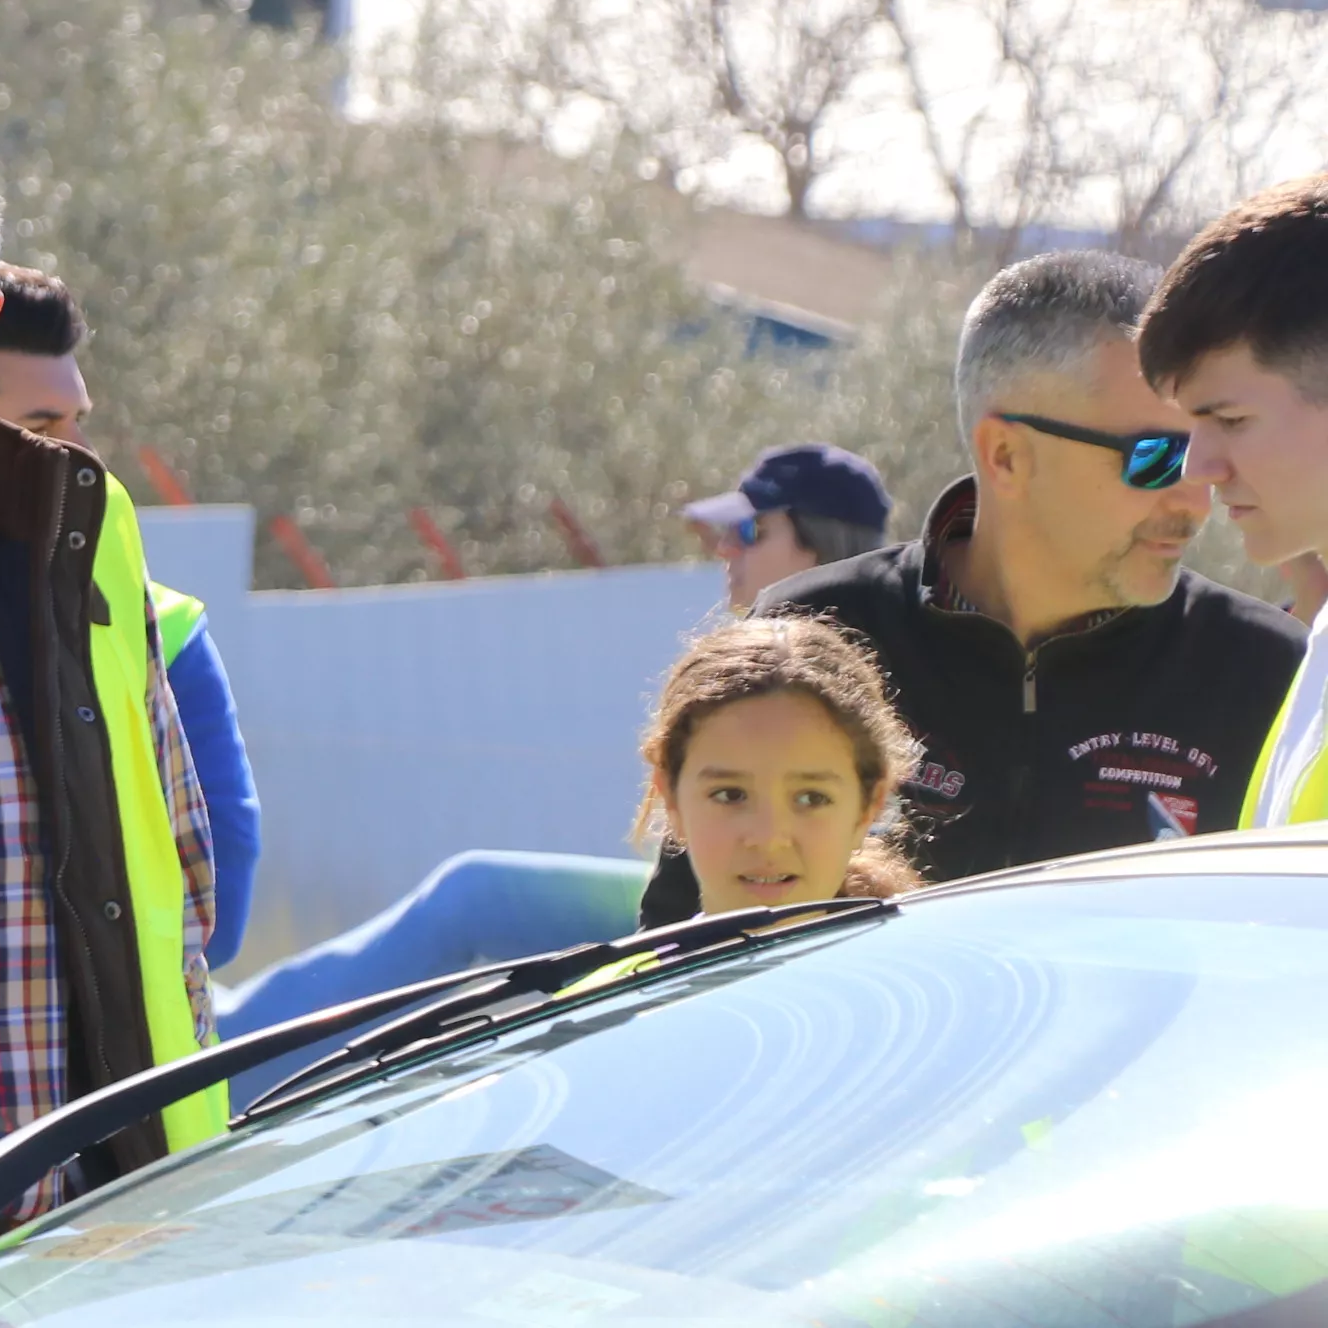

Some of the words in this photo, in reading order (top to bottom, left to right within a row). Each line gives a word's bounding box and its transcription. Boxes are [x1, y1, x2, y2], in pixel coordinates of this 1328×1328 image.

[1068, 732, 1123, 761] ENTRY
[1131, 731, 1180, 754] LEVEL
[1098, 766, 1183, 790] COMPETITION
